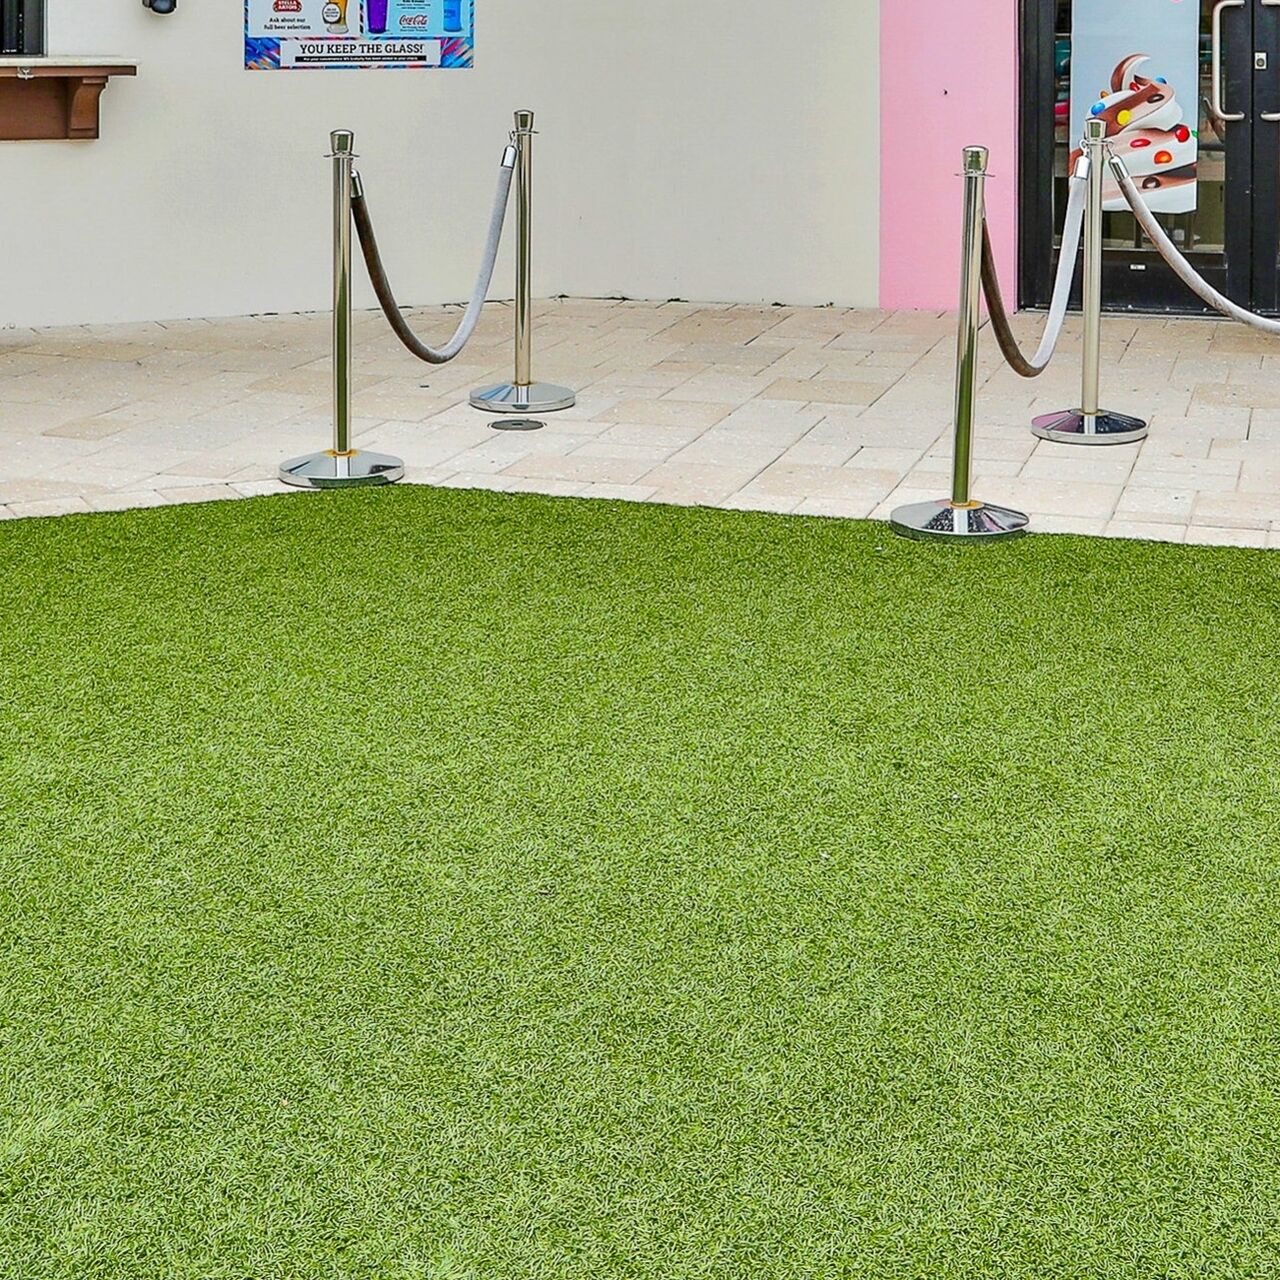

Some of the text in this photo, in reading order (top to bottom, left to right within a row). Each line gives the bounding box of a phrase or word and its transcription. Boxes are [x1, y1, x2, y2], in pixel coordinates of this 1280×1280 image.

[300, 43, 423, 54] YOU KEEP THE GLASS!
